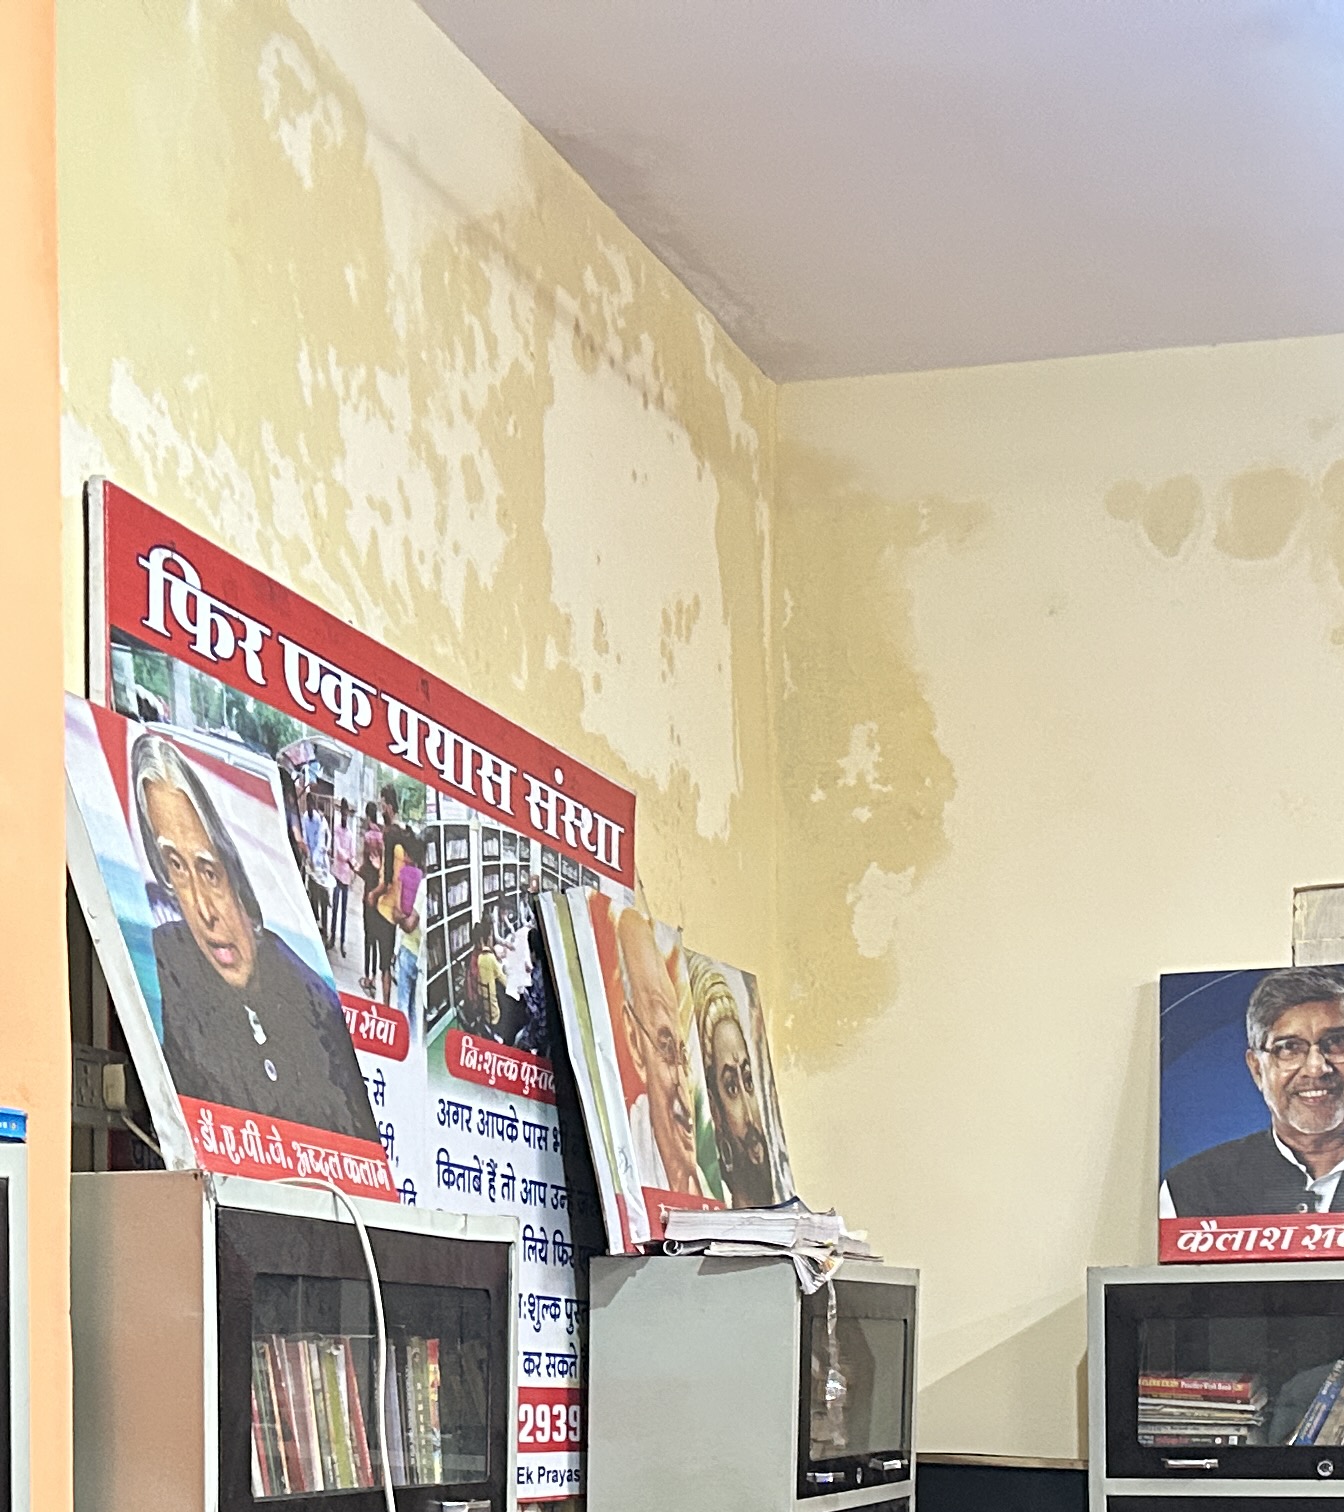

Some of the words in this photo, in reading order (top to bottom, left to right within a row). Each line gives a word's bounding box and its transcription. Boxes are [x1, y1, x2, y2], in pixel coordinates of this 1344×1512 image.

[137, 544, 272, 686] फिर
[277, 634, 378, 735] एक
[380, 692, 518, 817] प्रयास
[521, 767, 625, 873] संस्था
[359, 1005, 398, 1046] सेवा
[437, 1098, 472, 1133] अगर
[477, 1104, 519, 1143] आपके
[522, 1121, 550, 1151] पास
[436, 1148, 483, 1196] किताबें
[486, 1159, 498, 1203] हैं
[501, 1162, 516, 1203] तो
[520, 1178, 547, 1208] आप
[522, 1224, 549, 1265] लिये
[1177, 1220, 1298, 1253] कैलाश
[518, 1292, 561, 1333] :शुल्क
[522, 1351, 542, 1378] कर
[545, 1343, 579, 1379] सकते
[518, 1403, 581, 1443] 2939
[517, 1466, 534, 1485] Ek
[537, 1466, 581, 1487] Prayas
